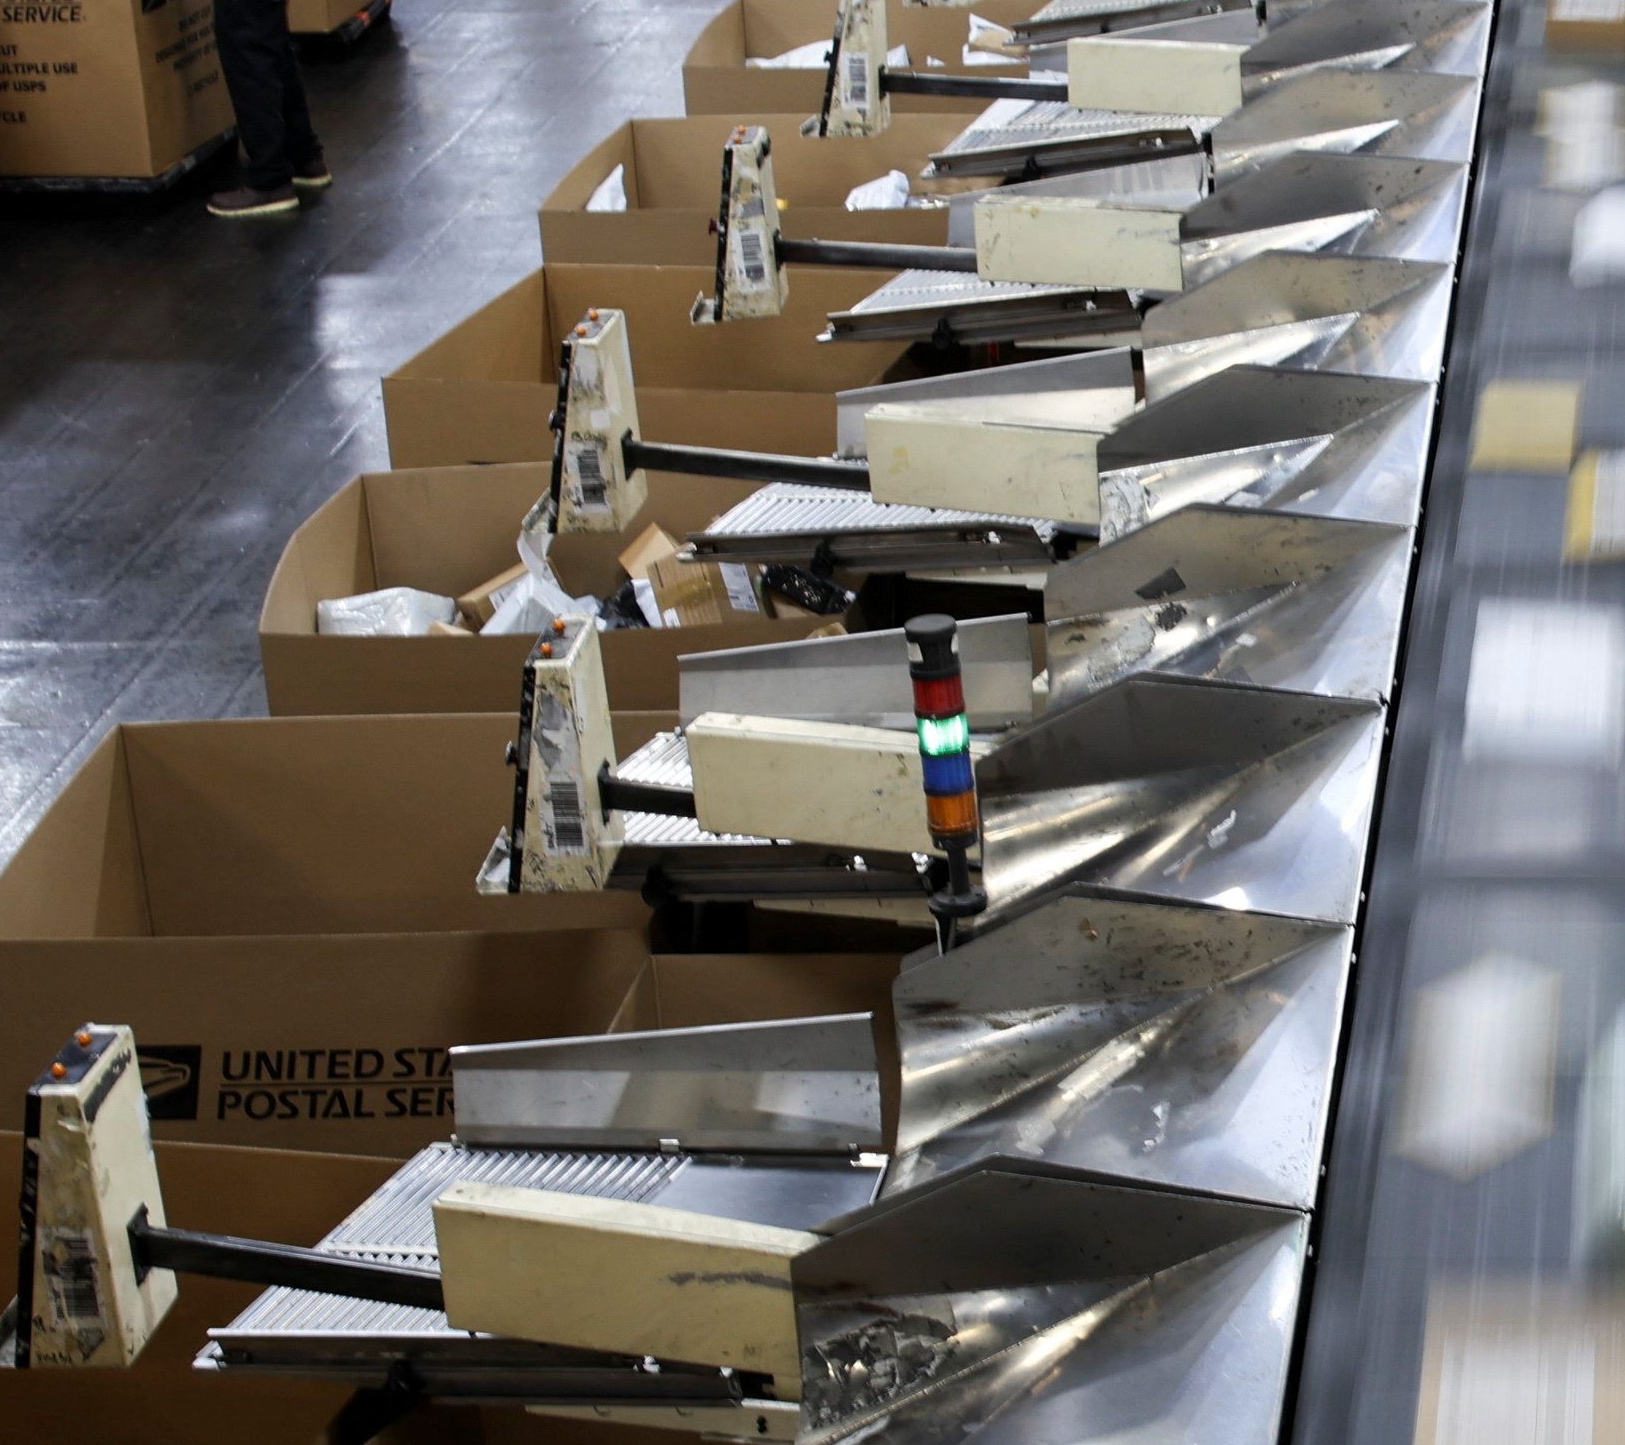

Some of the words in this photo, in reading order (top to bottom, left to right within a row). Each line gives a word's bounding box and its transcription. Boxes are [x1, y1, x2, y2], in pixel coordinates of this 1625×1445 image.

[3, 5, 81, 23] SERVICE
[52, 62, 78, 74] USE
[13, 81, 46, 93] USPS
[222, 1048, 385, 1081] UNITED
[217, 1088, 375, 1120] POSTAL
